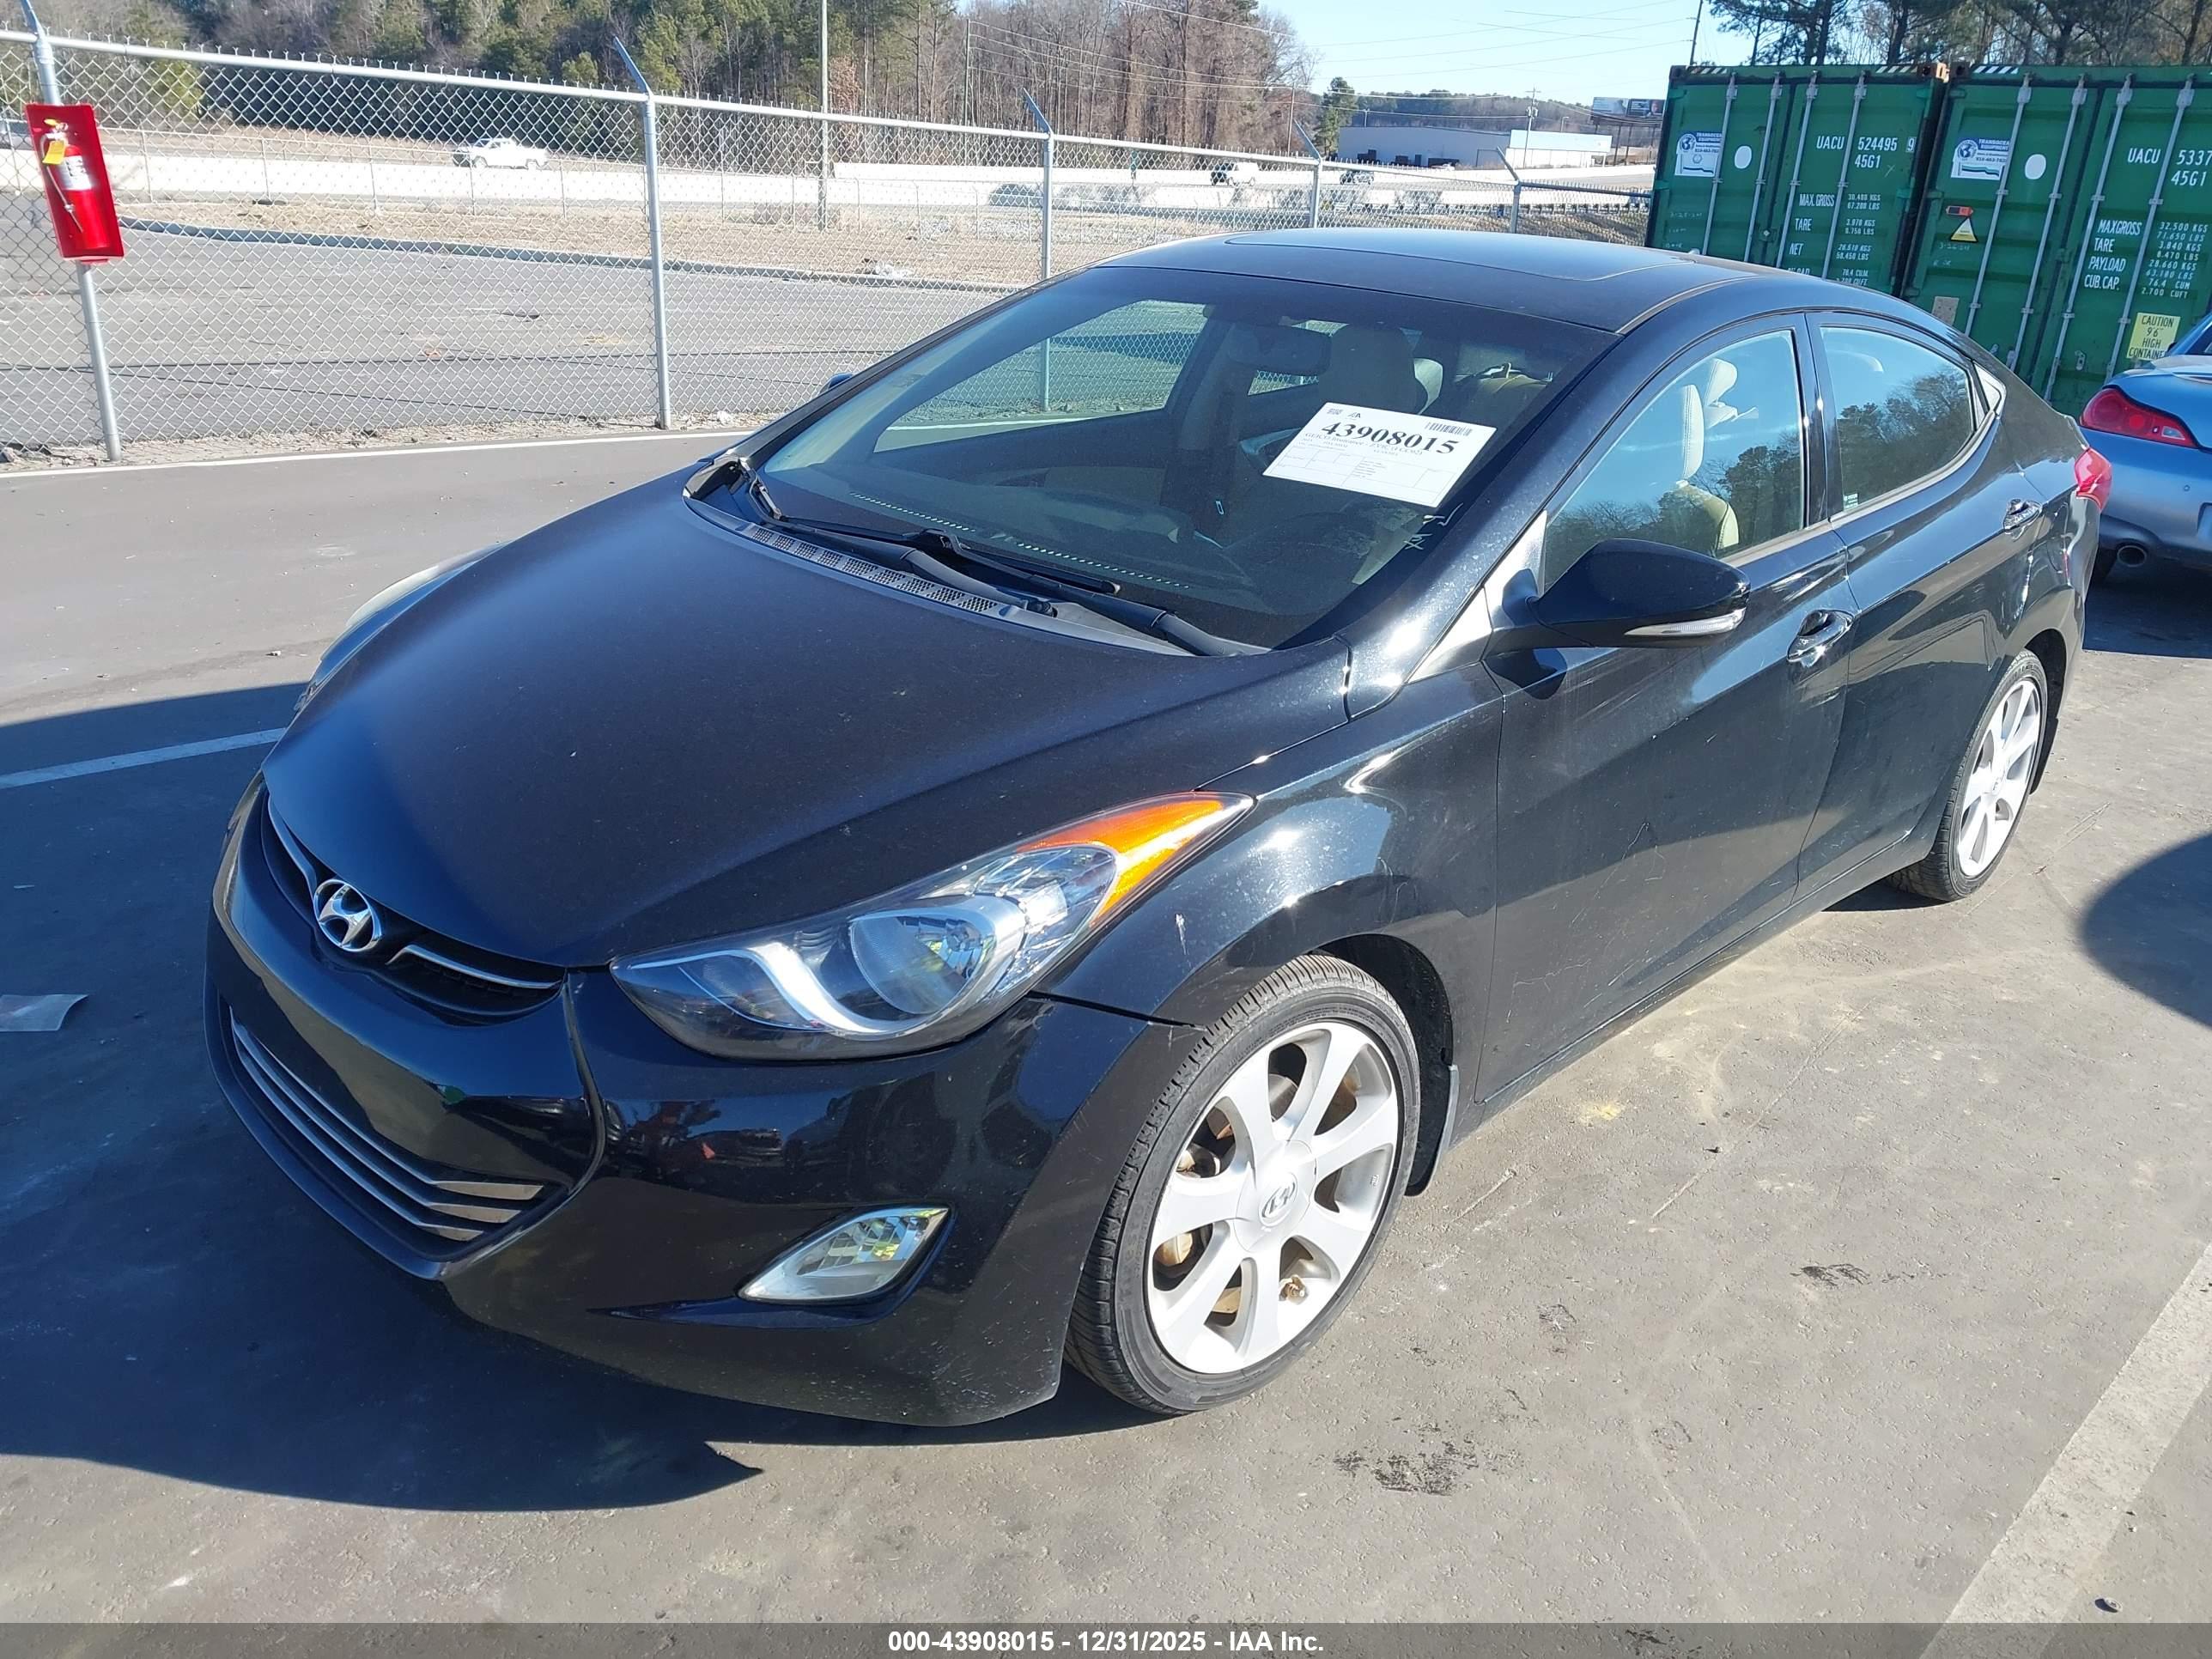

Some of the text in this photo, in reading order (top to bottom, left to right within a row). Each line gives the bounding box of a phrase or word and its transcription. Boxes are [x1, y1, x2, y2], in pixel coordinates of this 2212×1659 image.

[1816, 136, 1916, 151] UACU 524495 9
[1855, 154, 1881, 168] 45G1
[2127, 148, 2161, 164] UACU
[2171, 170, 2207, 186] 45G1
[1795, 218, 1812, 231] TARE
[2159, 222, 2209, 233] 32.500 KGS
[2157, 231, 2205, 242] 71.650 LBS
[1789, 243, 1804, 256] NET
[2094, 237, 2115, 252] TARE
[2159, 240, 2202, 252] 3.840 KGS
[1858, 252, 1869, 261] LBS
[2156, 250, 2199, 261] 8.470 LBS
[2088, 256, 2126, 272] PAYLOAD
[2148, 259, 2197, 270] 28.660 KGS
[2148, 278, 2191, 289] 76.4 CUM
[2141, 287, 2189, 299] 2.700 CUFT
[2142, 315, 2174, 328] CAUTION
[2142, 337, 2161, 349] HIGH
[2129, 347, 2166, 359] CONTAINE
[1321, 422, 1460, 454] 43908015
